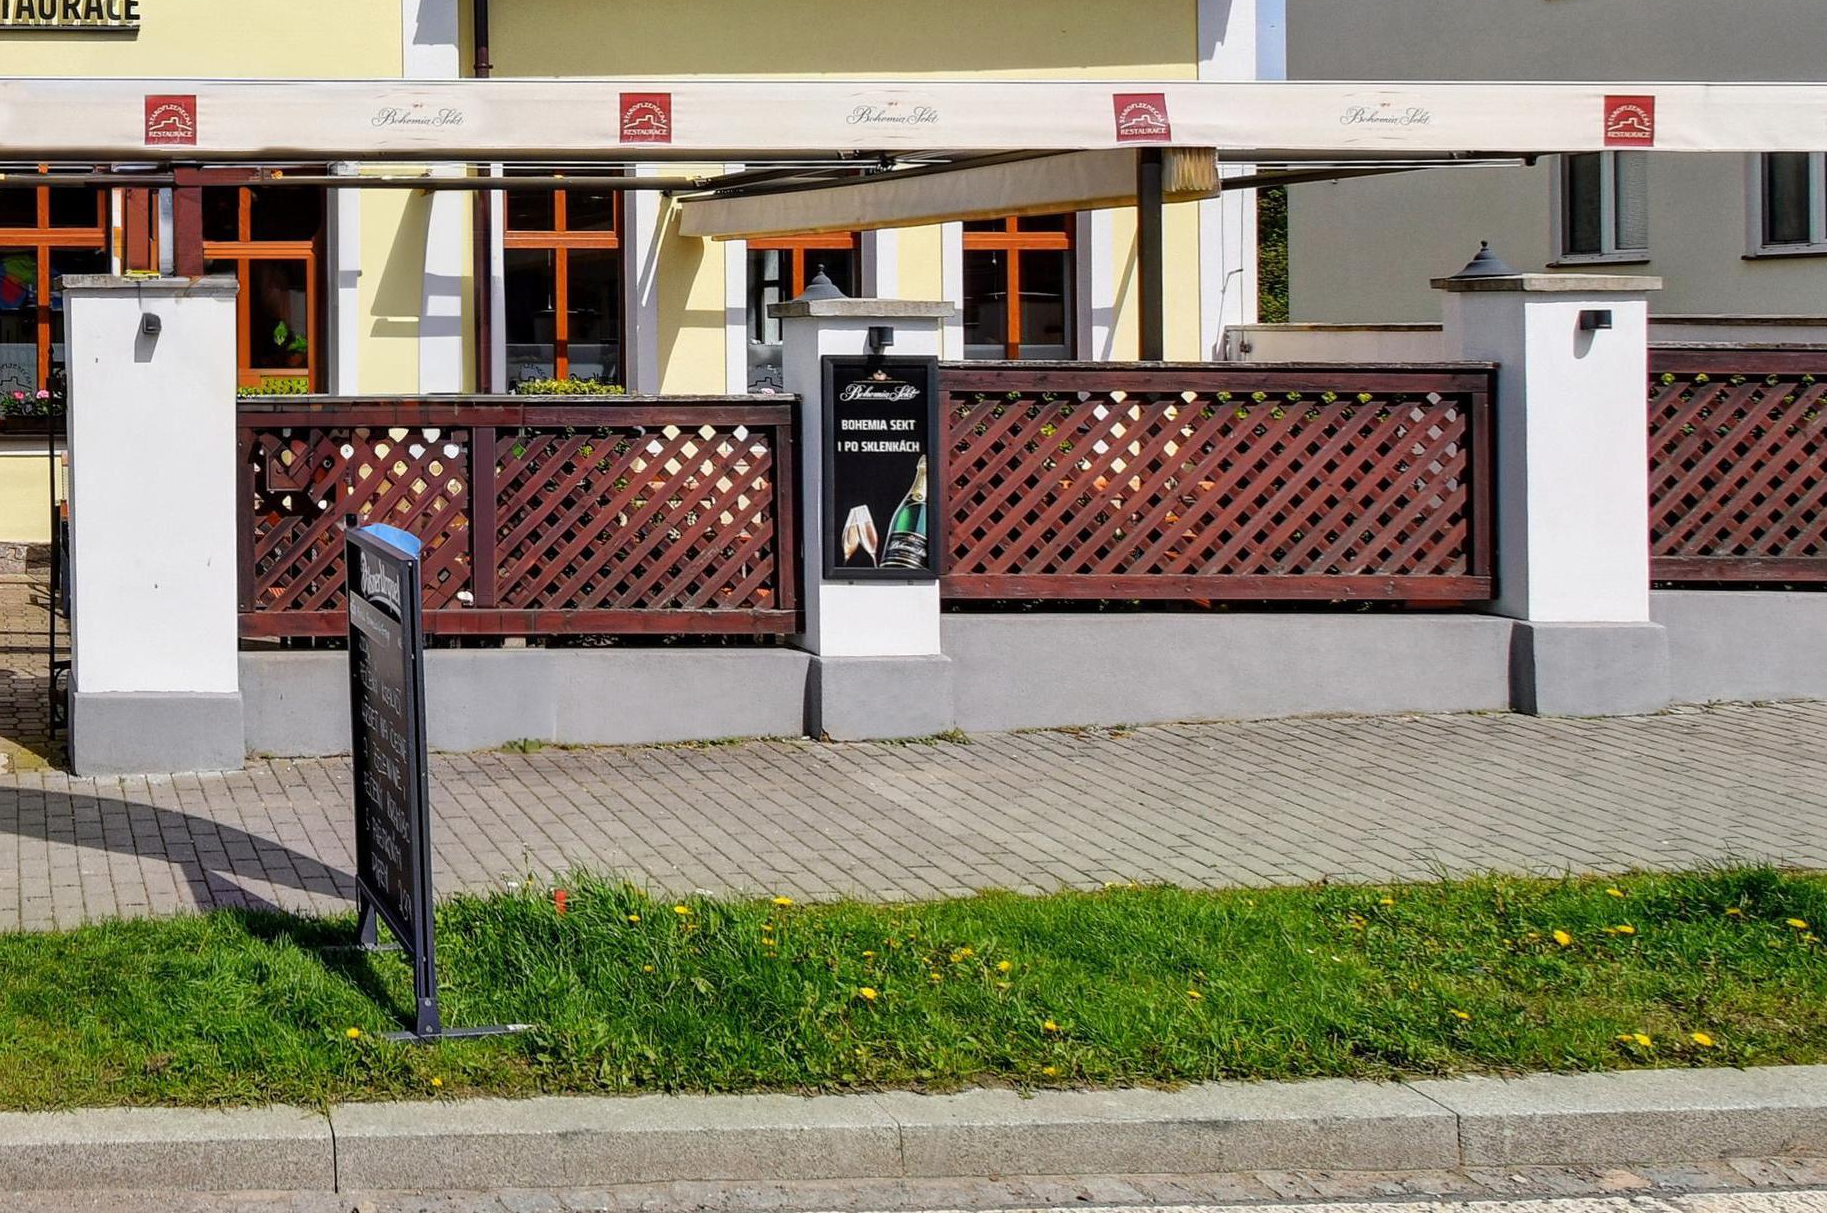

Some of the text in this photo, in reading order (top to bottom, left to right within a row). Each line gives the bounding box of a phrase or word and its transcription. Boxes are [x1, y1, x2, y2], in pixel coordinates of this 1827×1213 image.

[372, 108, 463, 126] Bohemia Sekt
[845, 106, 938, 125] Bohemia Sekt
[1340, 107, 1430, 125] Bohemia Sekt
[1120, 128, 1168, 136] RESTAURACE
[840, 384, 920, 401] Bohemia Sekt
[841, 419, 916, 431] BOHEMIA SEKT
[844, 441, 859, 452] PO
[861, 439, 920, 453] SKLENKÁCH
